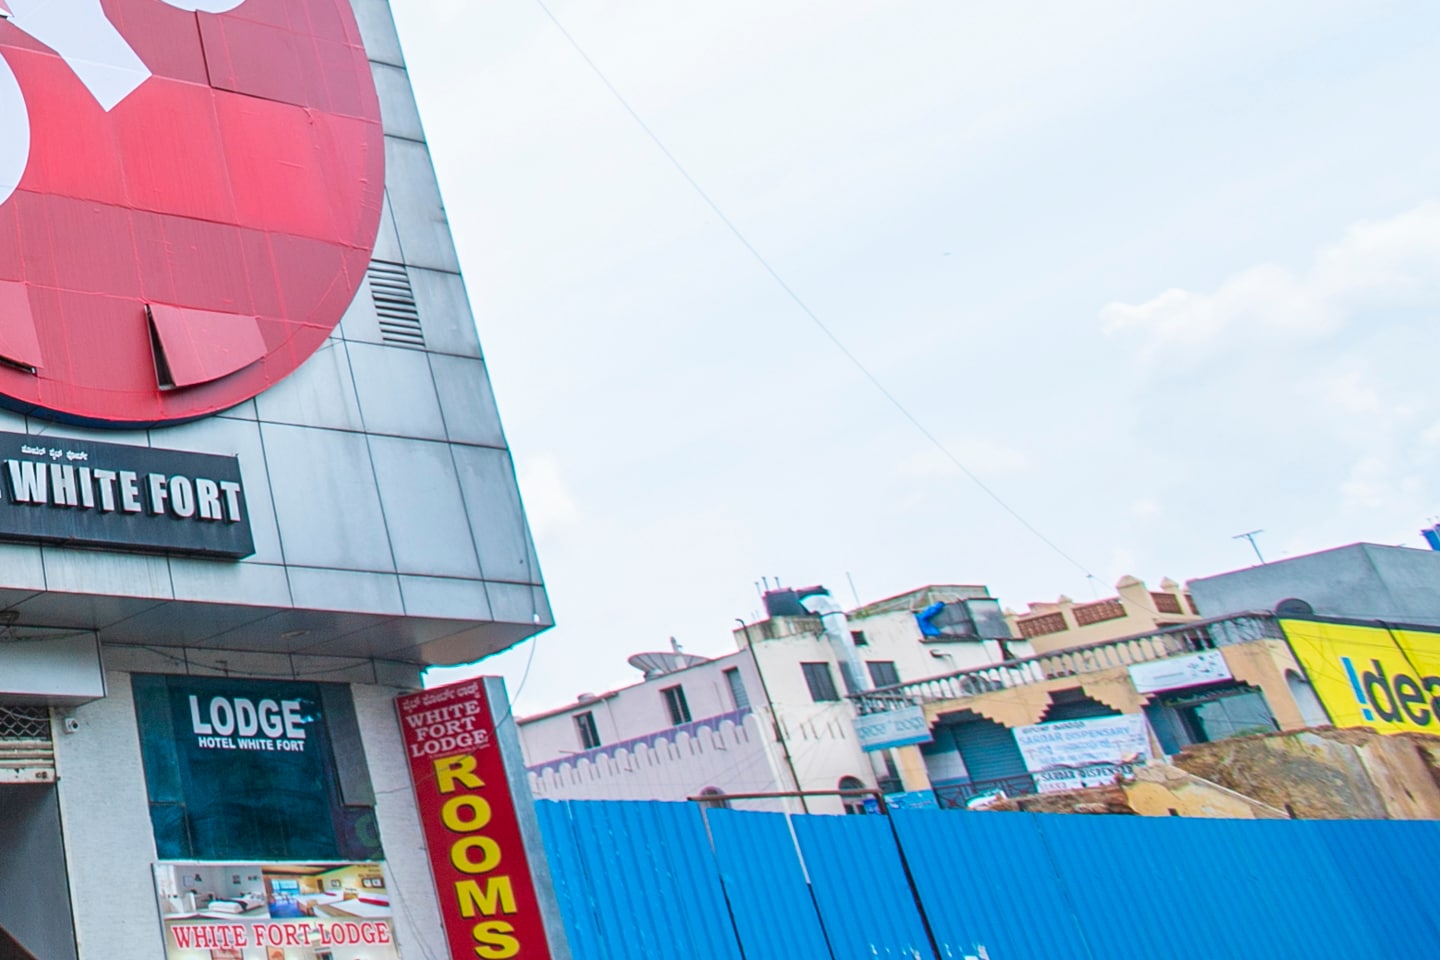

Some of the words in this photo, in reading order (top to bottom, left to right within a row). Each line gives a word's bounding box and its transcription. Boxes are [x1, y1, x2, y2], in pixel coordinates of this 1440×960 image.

[6, 458, 142, 514] WHITE
[146, 472, 241, 523] FORT
[188, 694, 306, 740] LODGE
[405, 700, 481, 729] WHITE
[415, 716, 476, 742] FORT
[198, 736, 236, 750] HOTEL
[237, 738, 274, 751] WHITE
[276, 739, 306, 752] FORT
[410, 728, 488, 758] LODGE
[433, 753, 521, 959] ROOMS
[172, 924, 248, 949] WHITE
[253, 923, 310, 947] FORT
[317, 922, 390, 946] LODGE
